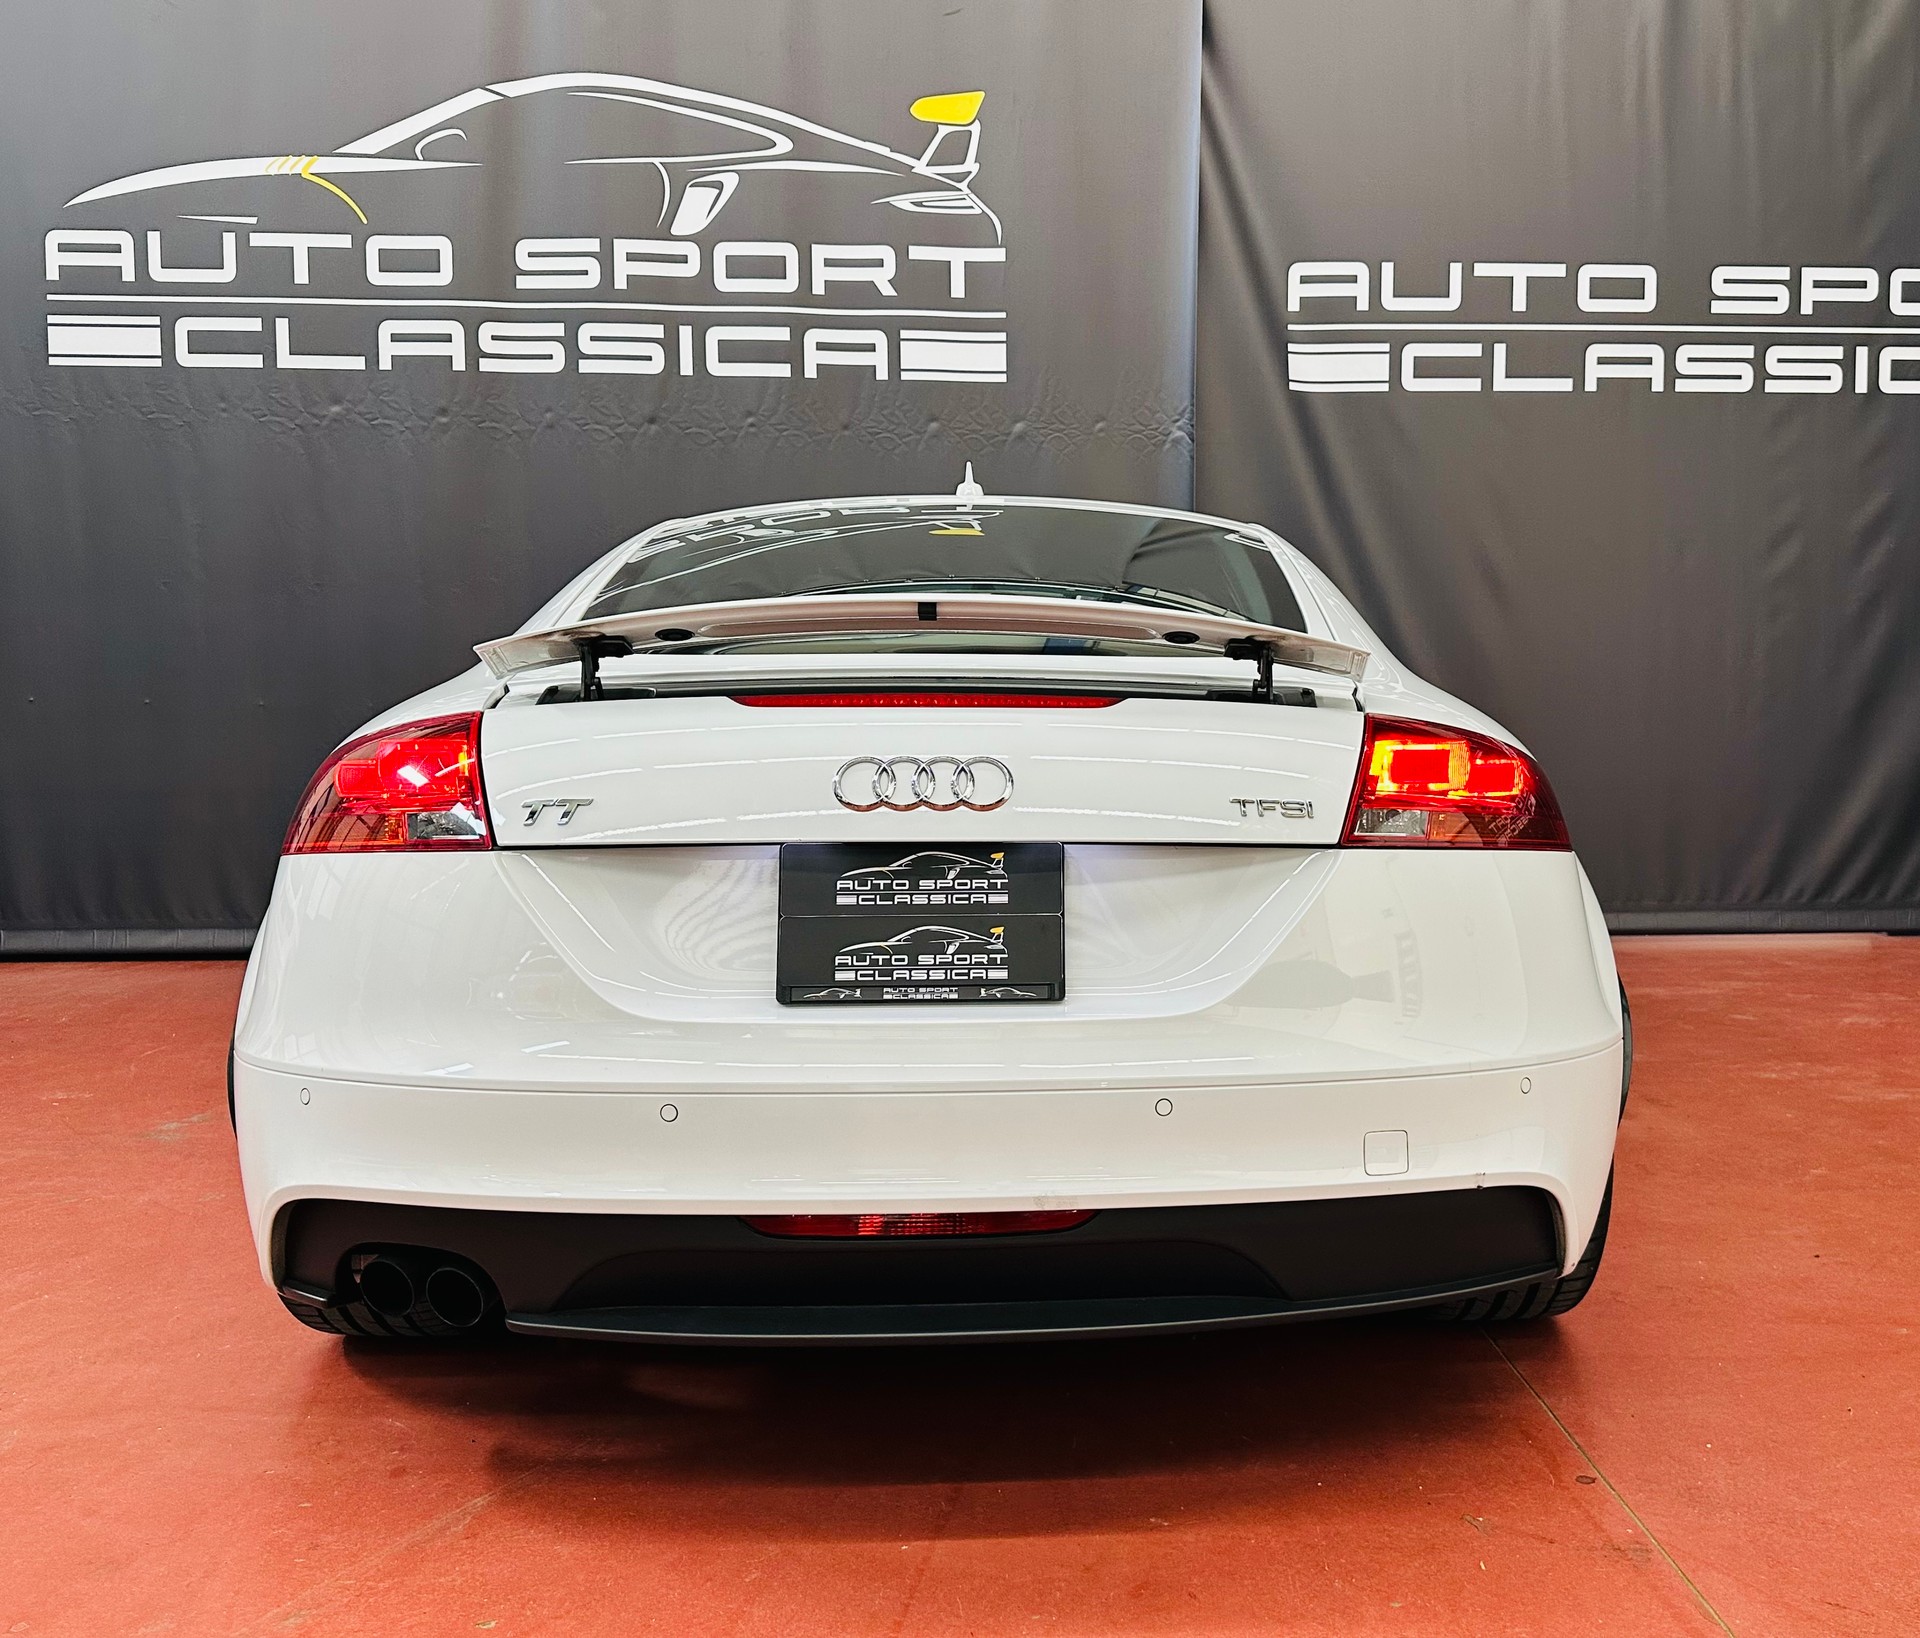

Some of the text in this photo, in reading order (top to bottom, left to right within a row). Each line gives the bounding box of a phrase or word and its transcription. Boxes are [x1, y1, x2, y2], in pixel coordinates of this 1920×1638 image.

[45, 229, 1006, 299] AUTO SPORT
[1288, 261, 1657, 313] AUTO
[174, 316, 889, 381] CLASSICA
[521, 798, 594, 826] TT
[1229, 797, 1315, 819] TFSI
[836, 879, 1009, 891] AUTO SPORT
[858, 893, 987, 905] CLASSICA
[834, 954, 1009, 966] AUTO SPORT
[856, 969, 987, 981] CLASSICA
